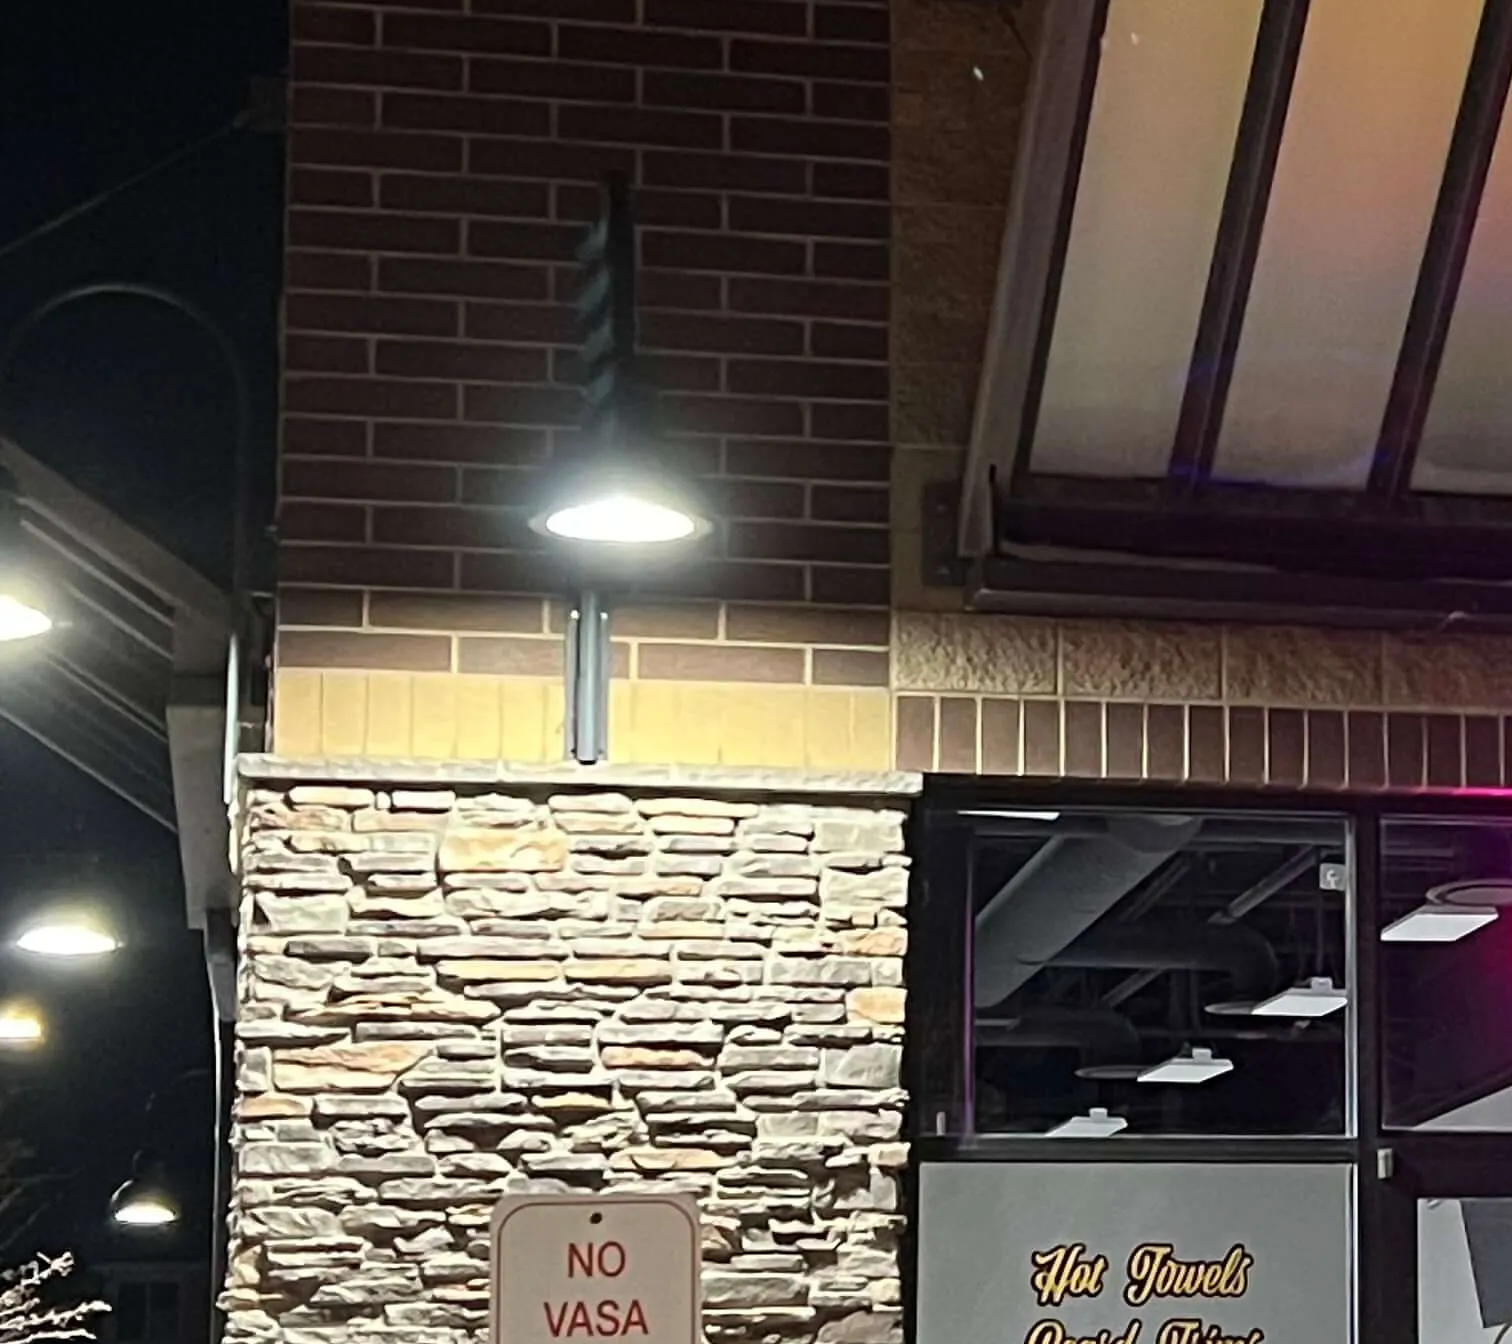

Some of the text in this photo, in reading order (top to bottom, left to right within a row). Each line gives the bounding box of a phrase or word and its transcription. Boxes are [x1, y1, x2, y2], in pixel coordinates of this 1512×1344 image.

[566, 1240, 628, 1278] NO
[1031, 1242, 1254, 1306] Hot Towels
[544, 1299, 649, 1337] VASA
